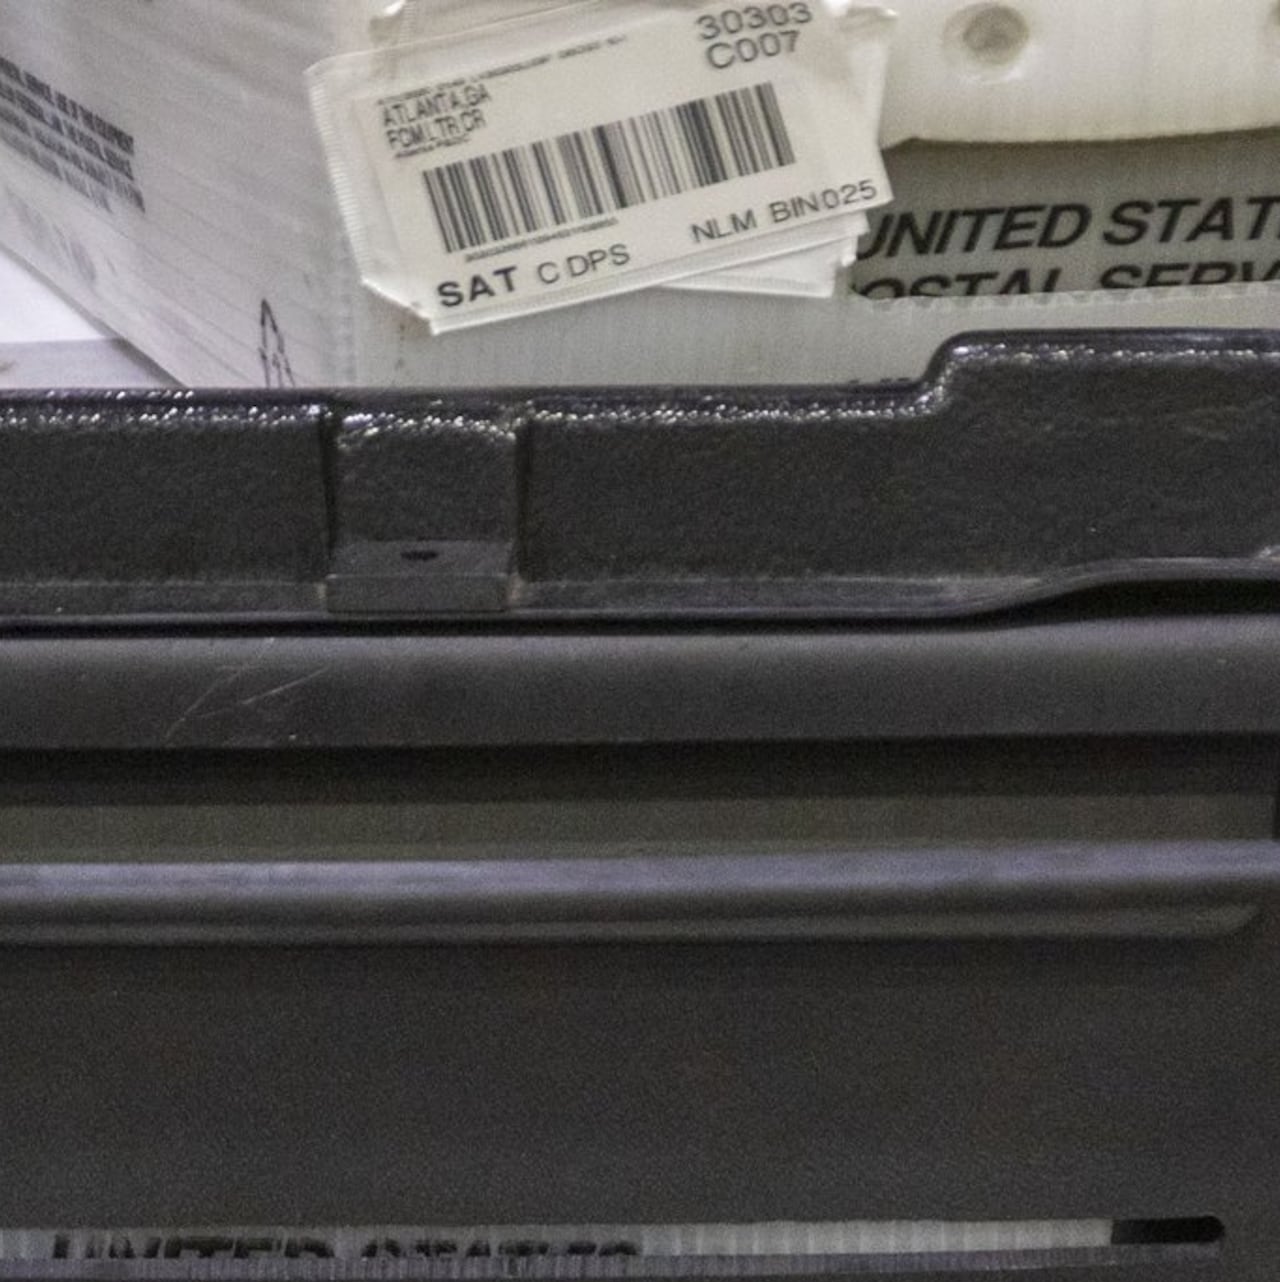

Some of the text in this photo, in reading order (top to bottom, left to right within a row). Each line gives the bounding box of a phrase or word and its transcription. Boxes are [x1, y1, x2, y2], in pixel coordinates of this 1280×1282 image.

[695, 2, 813, 40] 30303
[437, 265, 518, 307] SAT
[566, 242, 631, 278] DPS
[690, 208, 758, 244] NLM
